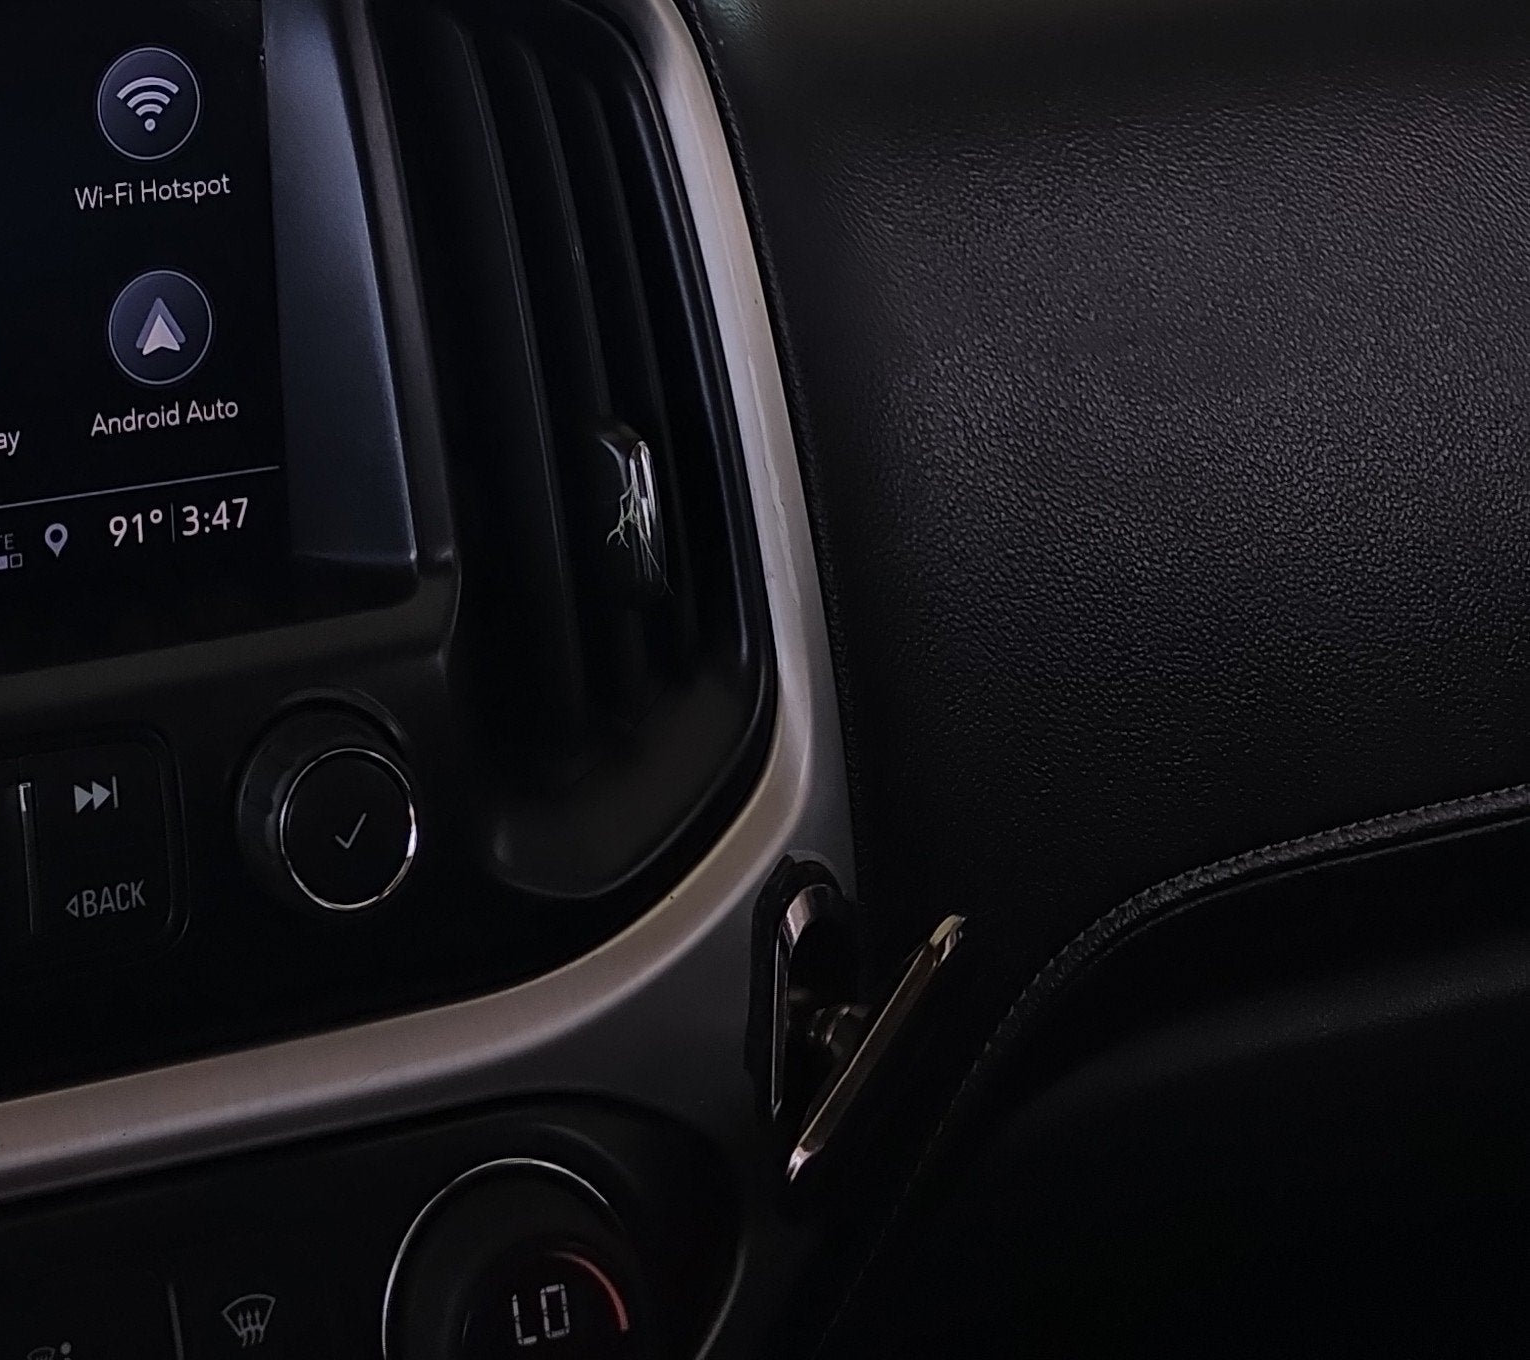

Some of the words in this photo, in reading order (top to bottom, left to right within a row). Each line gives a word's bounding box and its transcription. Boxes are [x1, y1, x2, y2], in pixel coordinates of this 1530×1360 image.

[75, 181, 133, 210] Wi-Fi
[140, 173, 232, 204] Hotspot
[90, 401, 180, 437] Android
[186, 397, 240, 424] Auto
[108, 508, 164, 548] 91°
[181, 496, 250, 537] 3:47
[81, 880, 146, 916] BACK
